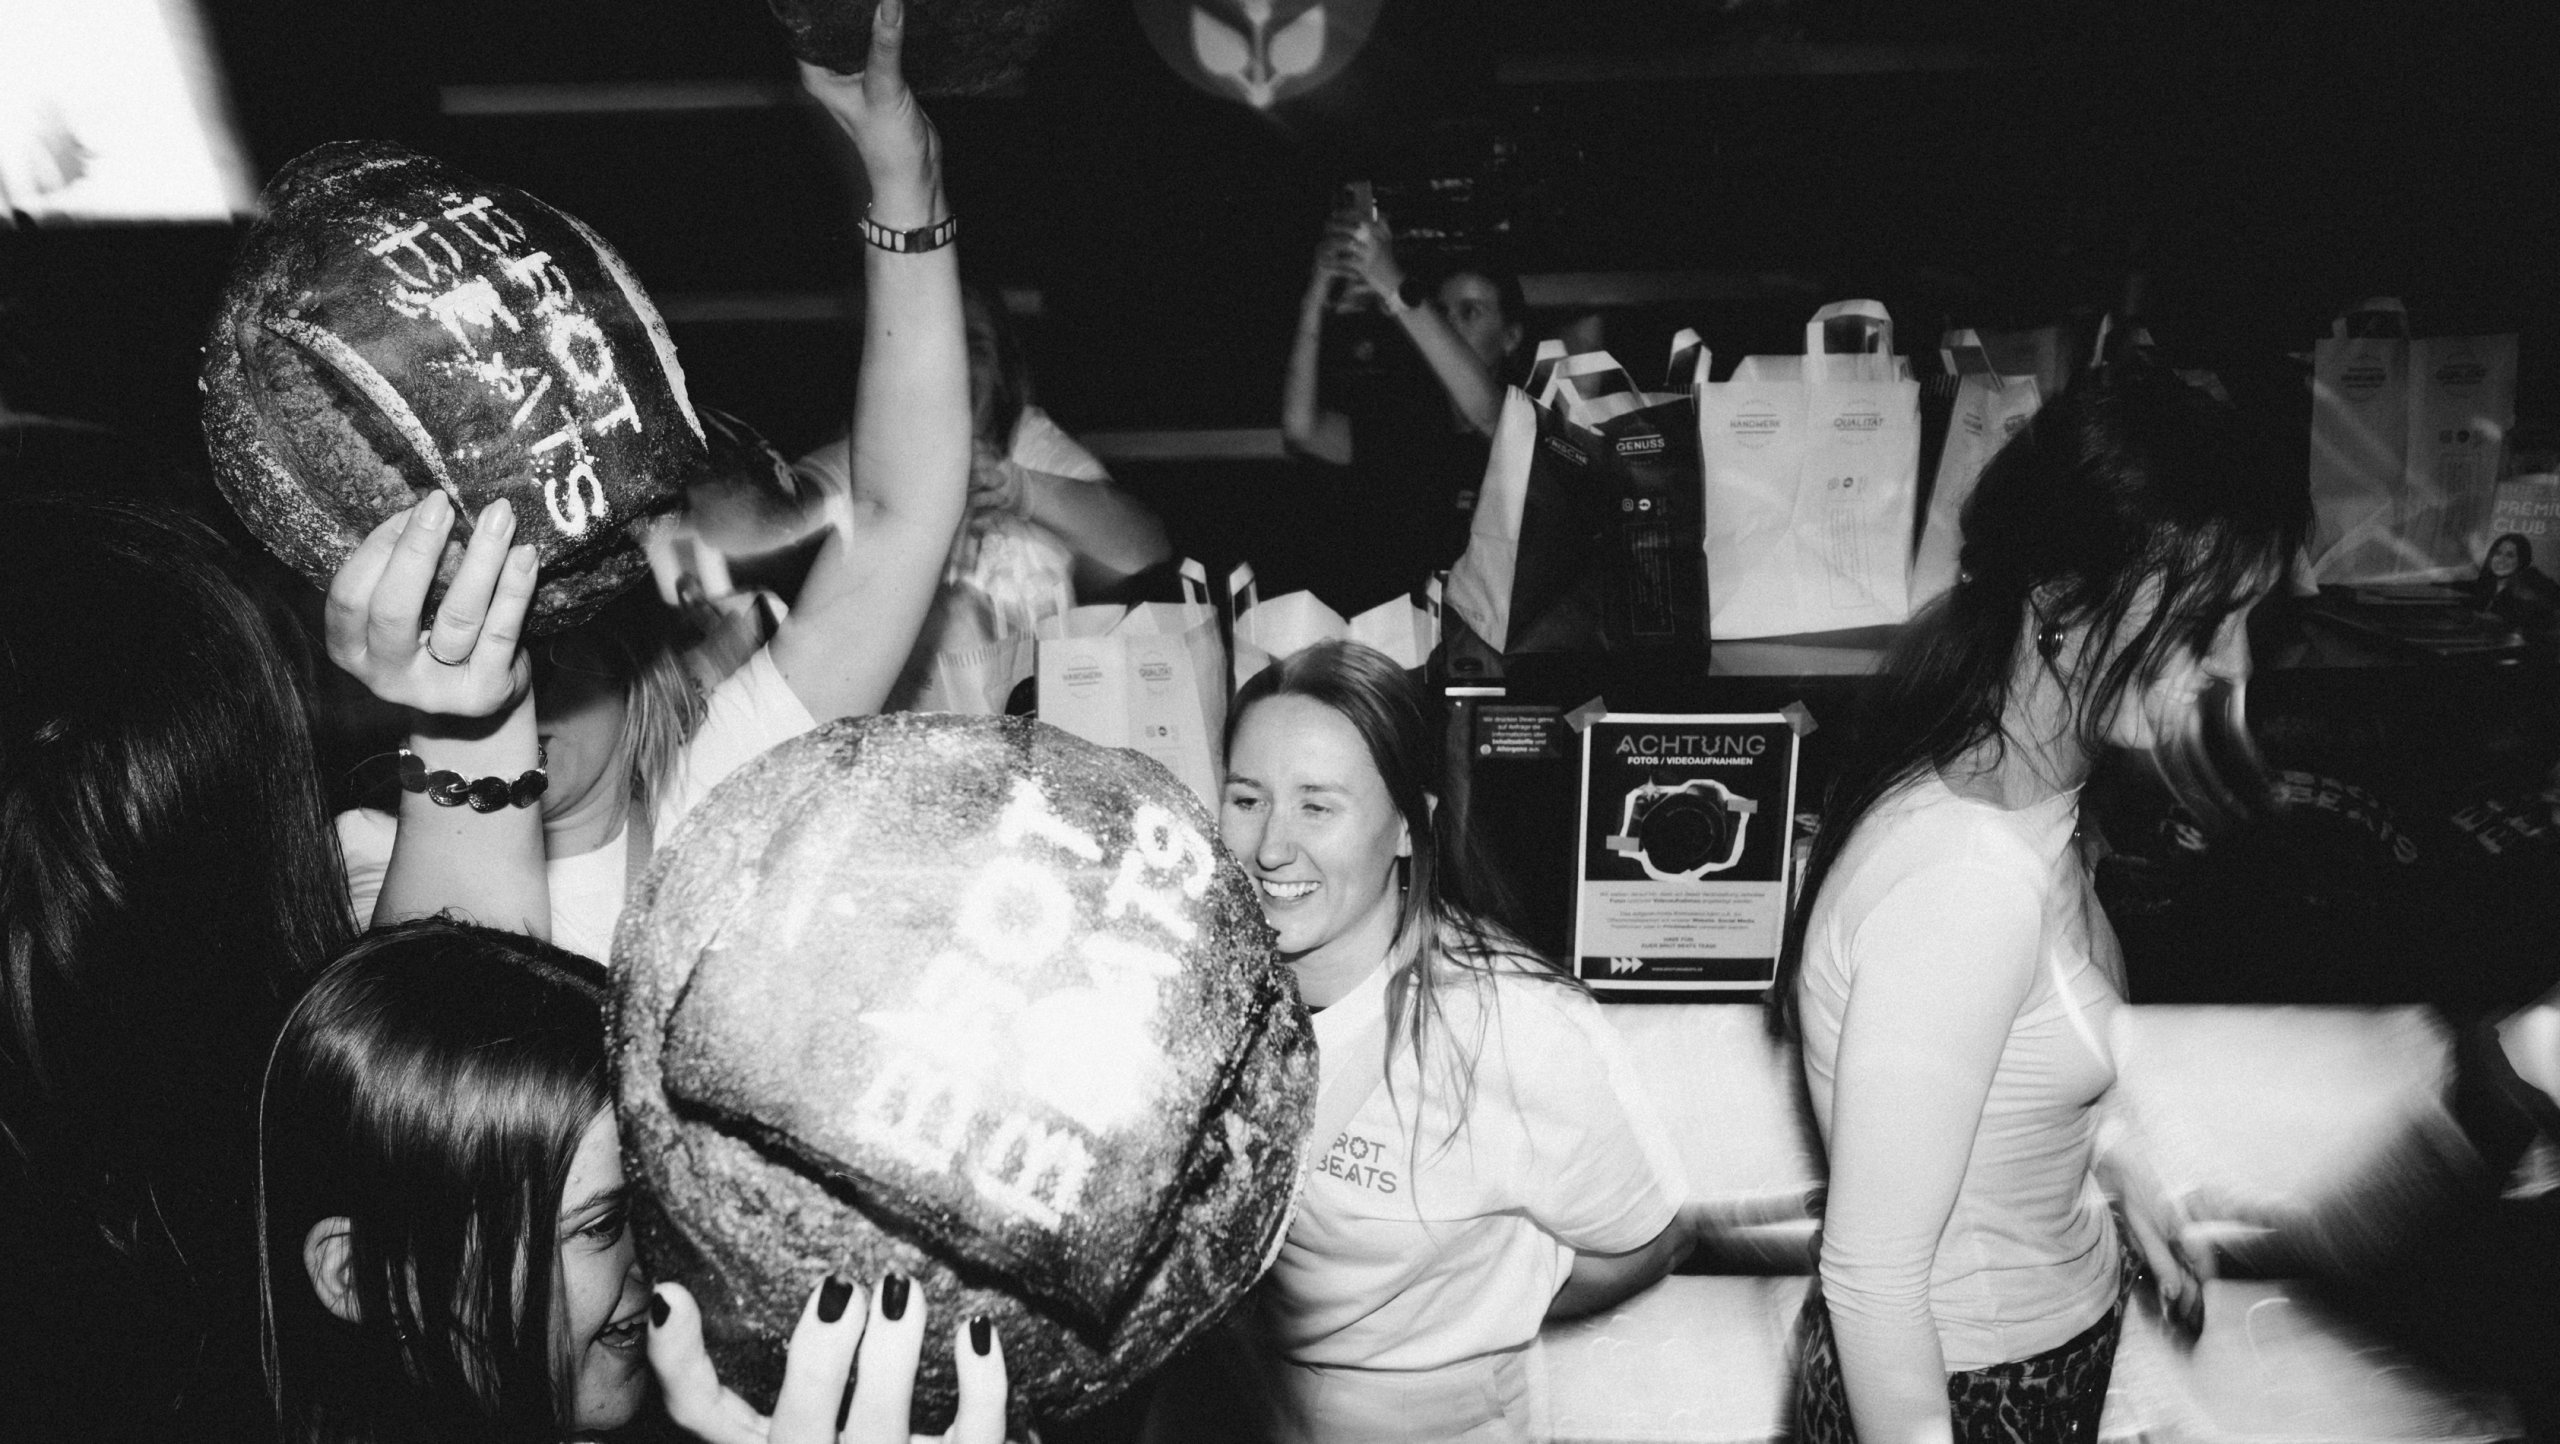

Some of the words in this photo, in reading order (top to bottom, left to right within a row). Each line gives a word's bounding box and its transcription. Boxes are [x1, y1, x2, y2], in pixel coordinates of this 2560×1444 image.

[1730, 419, 1781, 428] HANDWERK
[1616, 437, 1665, 452] GENUSS
[2496, 500, 2560, 517] PREMI
[2493, 518, 2546, 535] CLUB
[1616, 735, 1766, 755] ACHTUNG
[1627, 756, 1659, 765] FOTOS
[1666, 757, 1753, 765] VIDEOAUFNAHMEN
[1332, 1132, 1386, 1163] ROT
